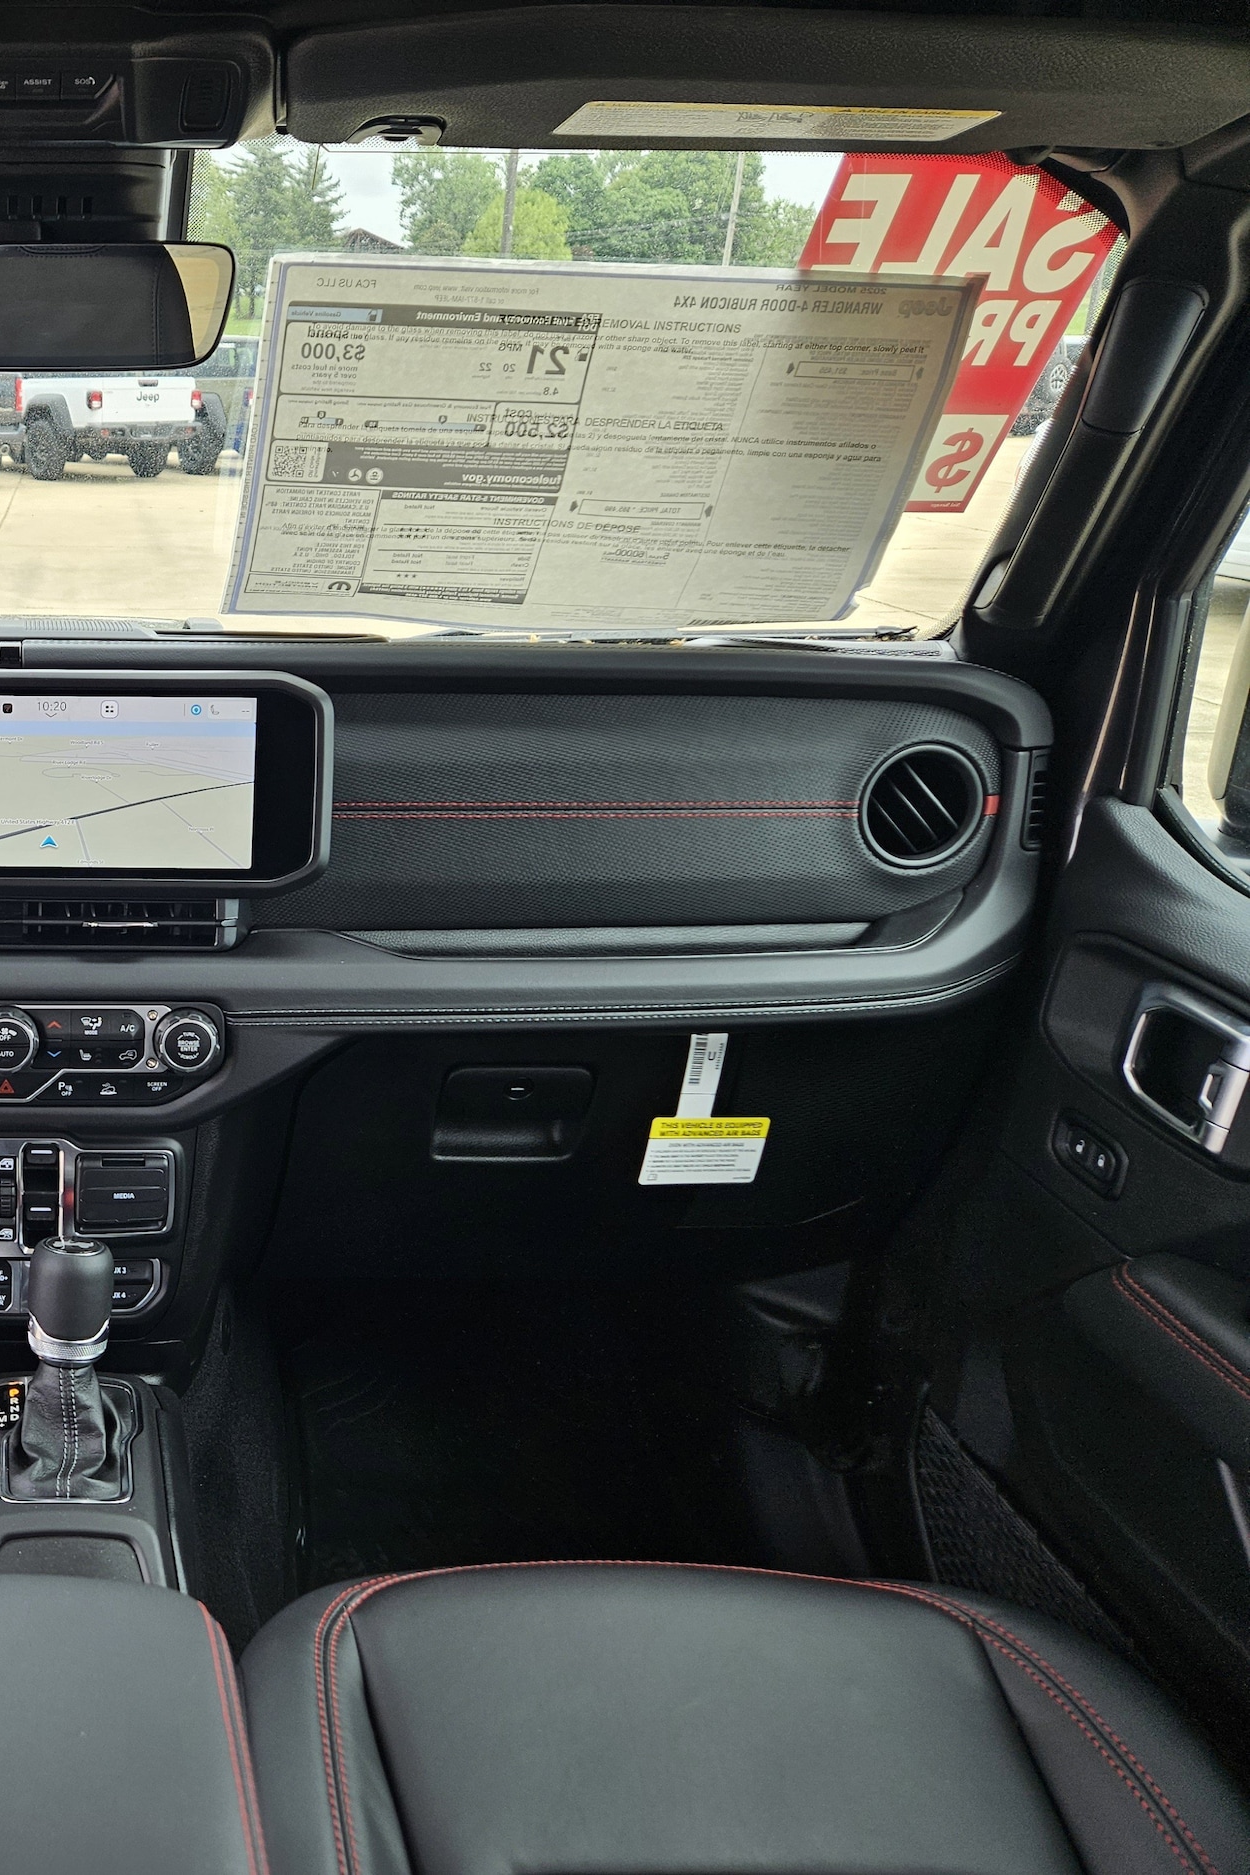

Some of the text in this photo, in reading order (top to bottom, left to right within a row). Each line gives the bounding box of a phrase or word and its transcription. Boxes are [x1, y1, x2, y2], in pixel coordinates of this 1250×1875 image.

[654, 320, 742, 334] INSTRUCTIONS
[628, 335, 650, 346] sharp
[651, 335, 679, 346] object.
[692, 338, 721, 347] remove
[722, 338, 738, 347] this
[762, 340, 794, 351] starting
[804, 341, 827, 351] either
[829, 343, 842, 354] top
[844, 344, 871, 354] corner,
[873, 344, 898, 355] slowly
[899, 345, 917, 355] peel
[622, 345, 652, 357] sponge
[136, 391, 160, 403] Jeep
[584, 417, 723, 432] DESPRENDER LA ETIQUETA
[36, 701, 67, 712] 10:20
[120, 1024, 135, 1033] A/C
[9, 1388, 20, 1397] P
[10, 1397, 19, 1405] R
[10, 1405, 20, 1413] N
